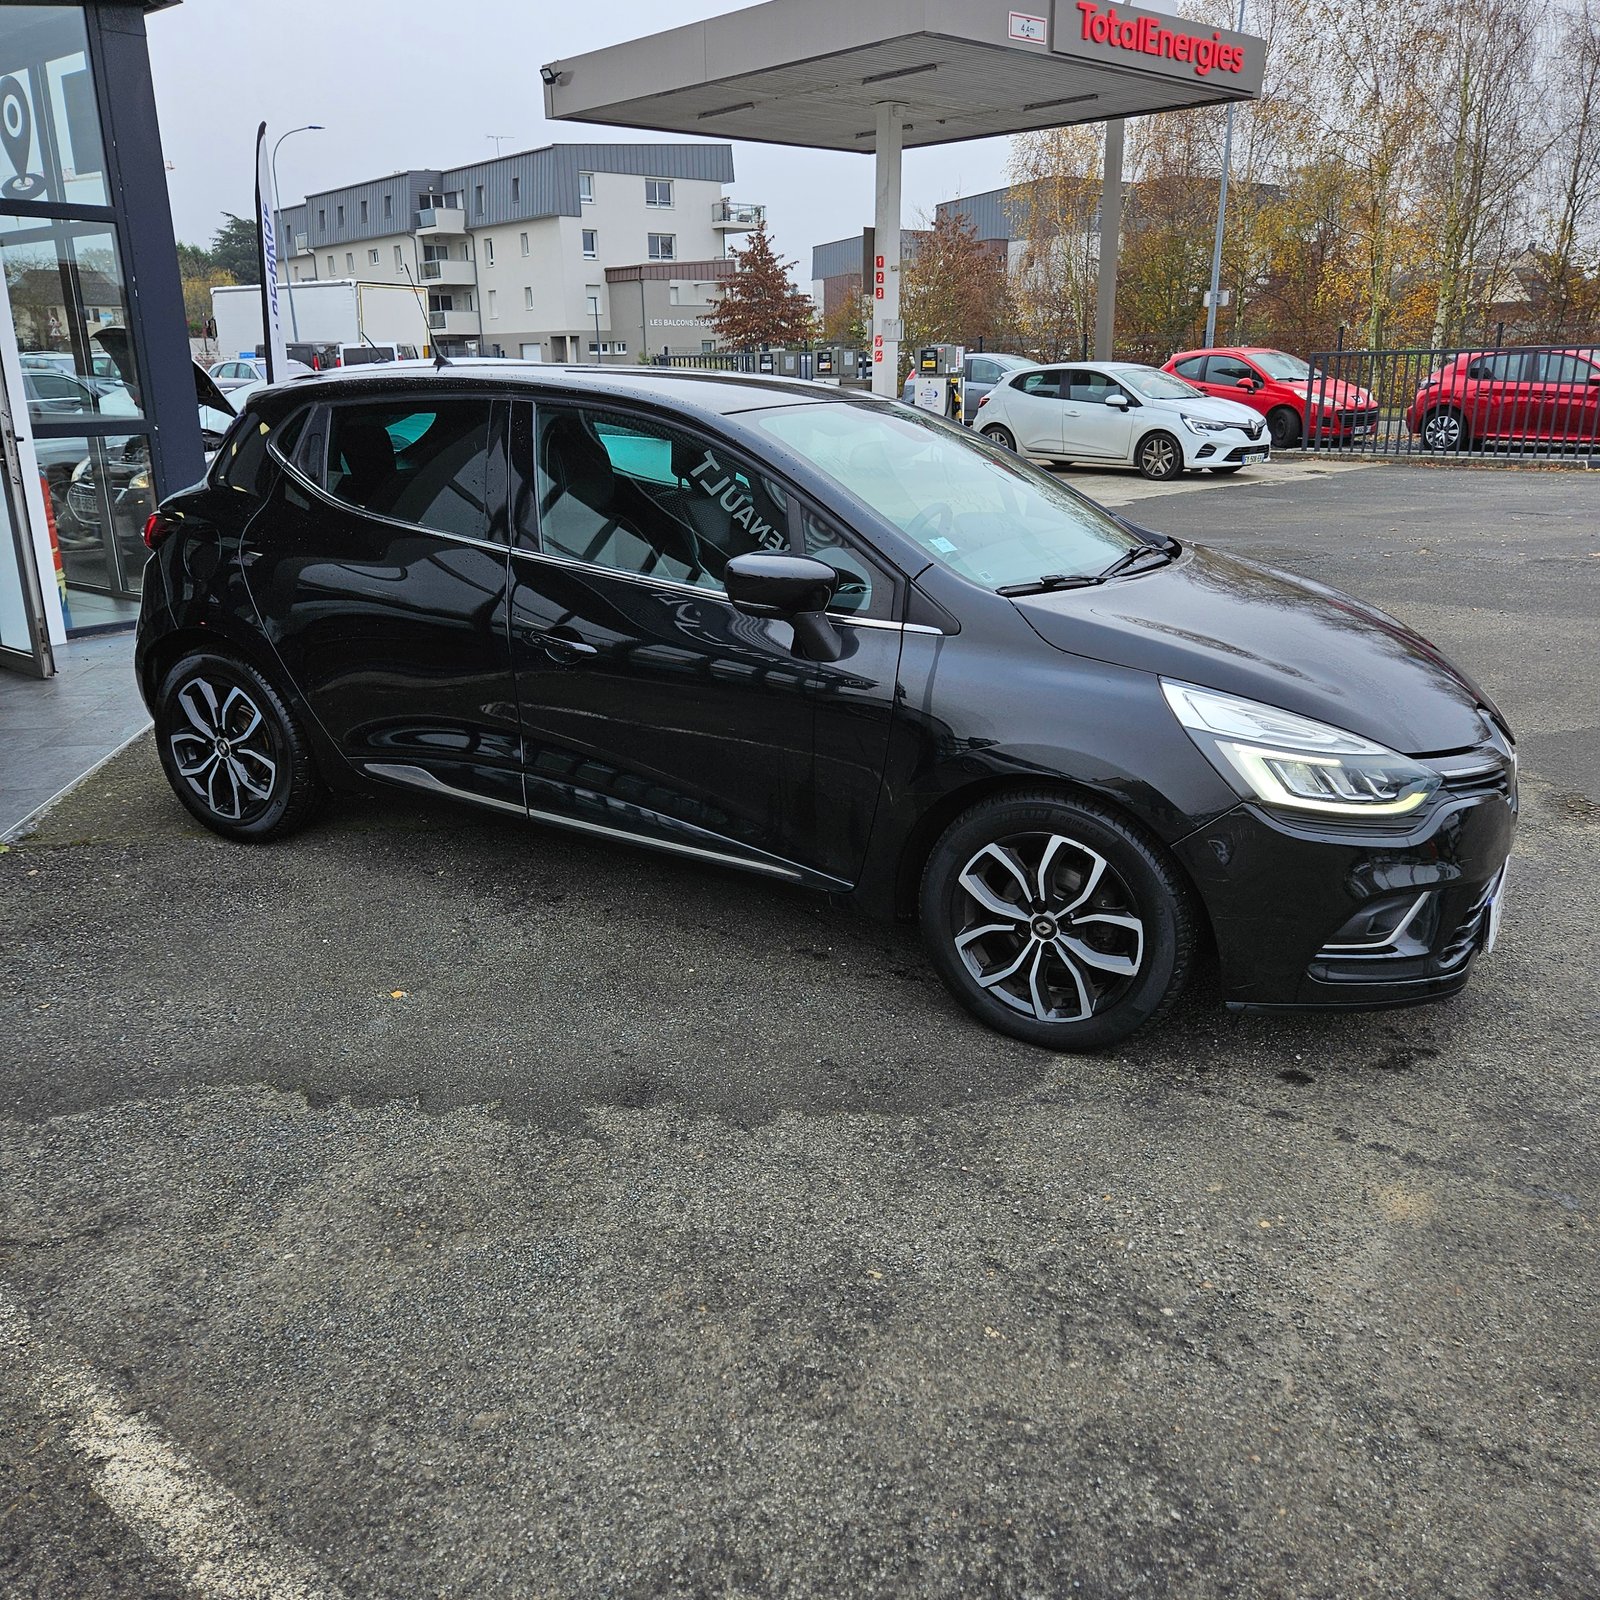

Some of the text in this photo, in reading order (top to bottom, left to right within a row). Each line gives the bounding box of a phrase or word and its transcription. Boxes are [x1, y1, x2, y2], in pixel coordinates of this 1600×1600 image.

[1076, 1, 1245, 76] TotalEnergies
[877, 257, 882, 267] 1
[877, 273, 883, 282] 2
[877, 289, 883, 298] 3
[663, 319, 694, 327] BALCONS
